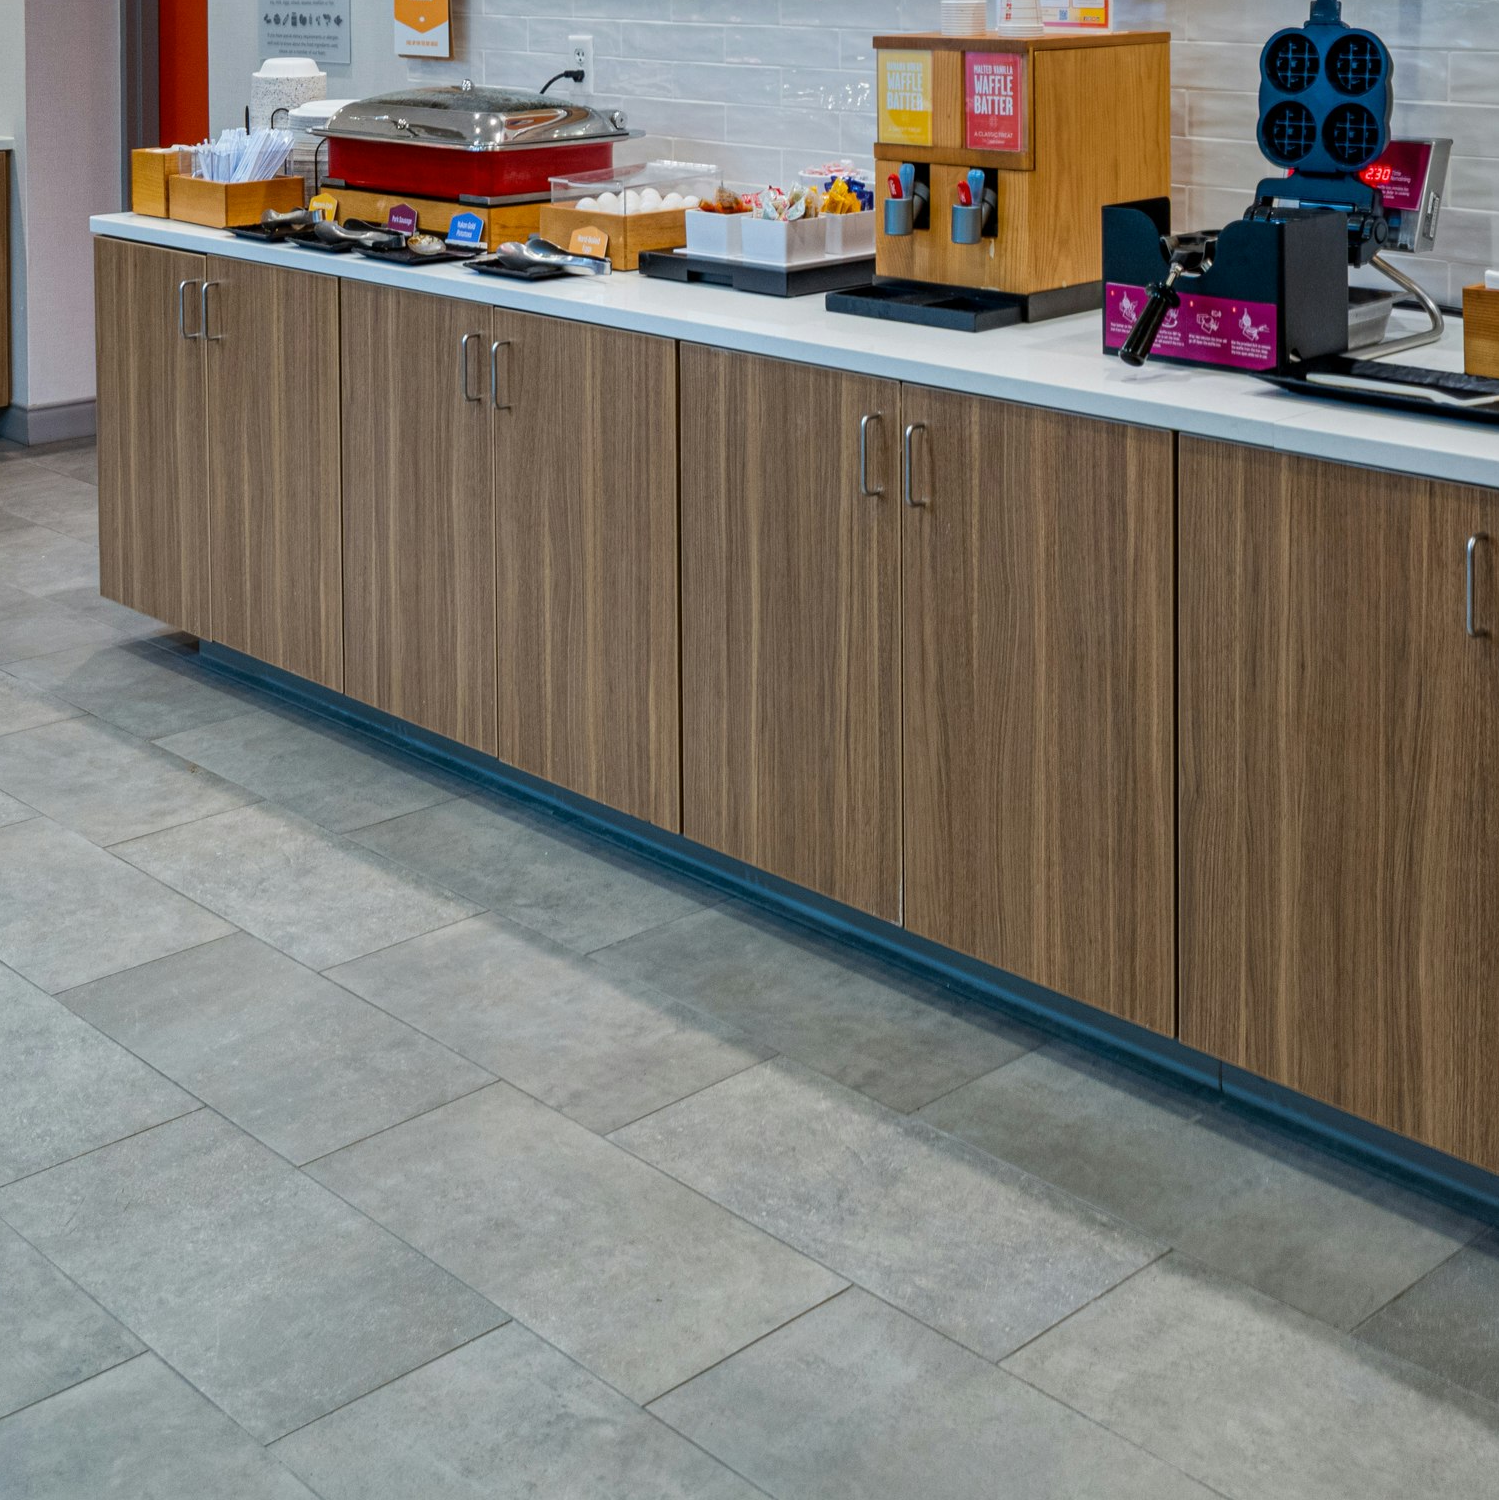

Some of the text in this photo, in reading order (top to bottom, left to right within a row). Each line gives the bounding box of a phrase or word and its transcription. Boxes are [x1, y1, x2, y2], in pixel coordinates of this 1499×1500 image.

[887, 72, 923, 92] WAFFLE
[974, 75, 1014, 96] WAFFLE
[886, 92, 923, 112] BATTER
[974, 96, 1014, 116] BATTER
